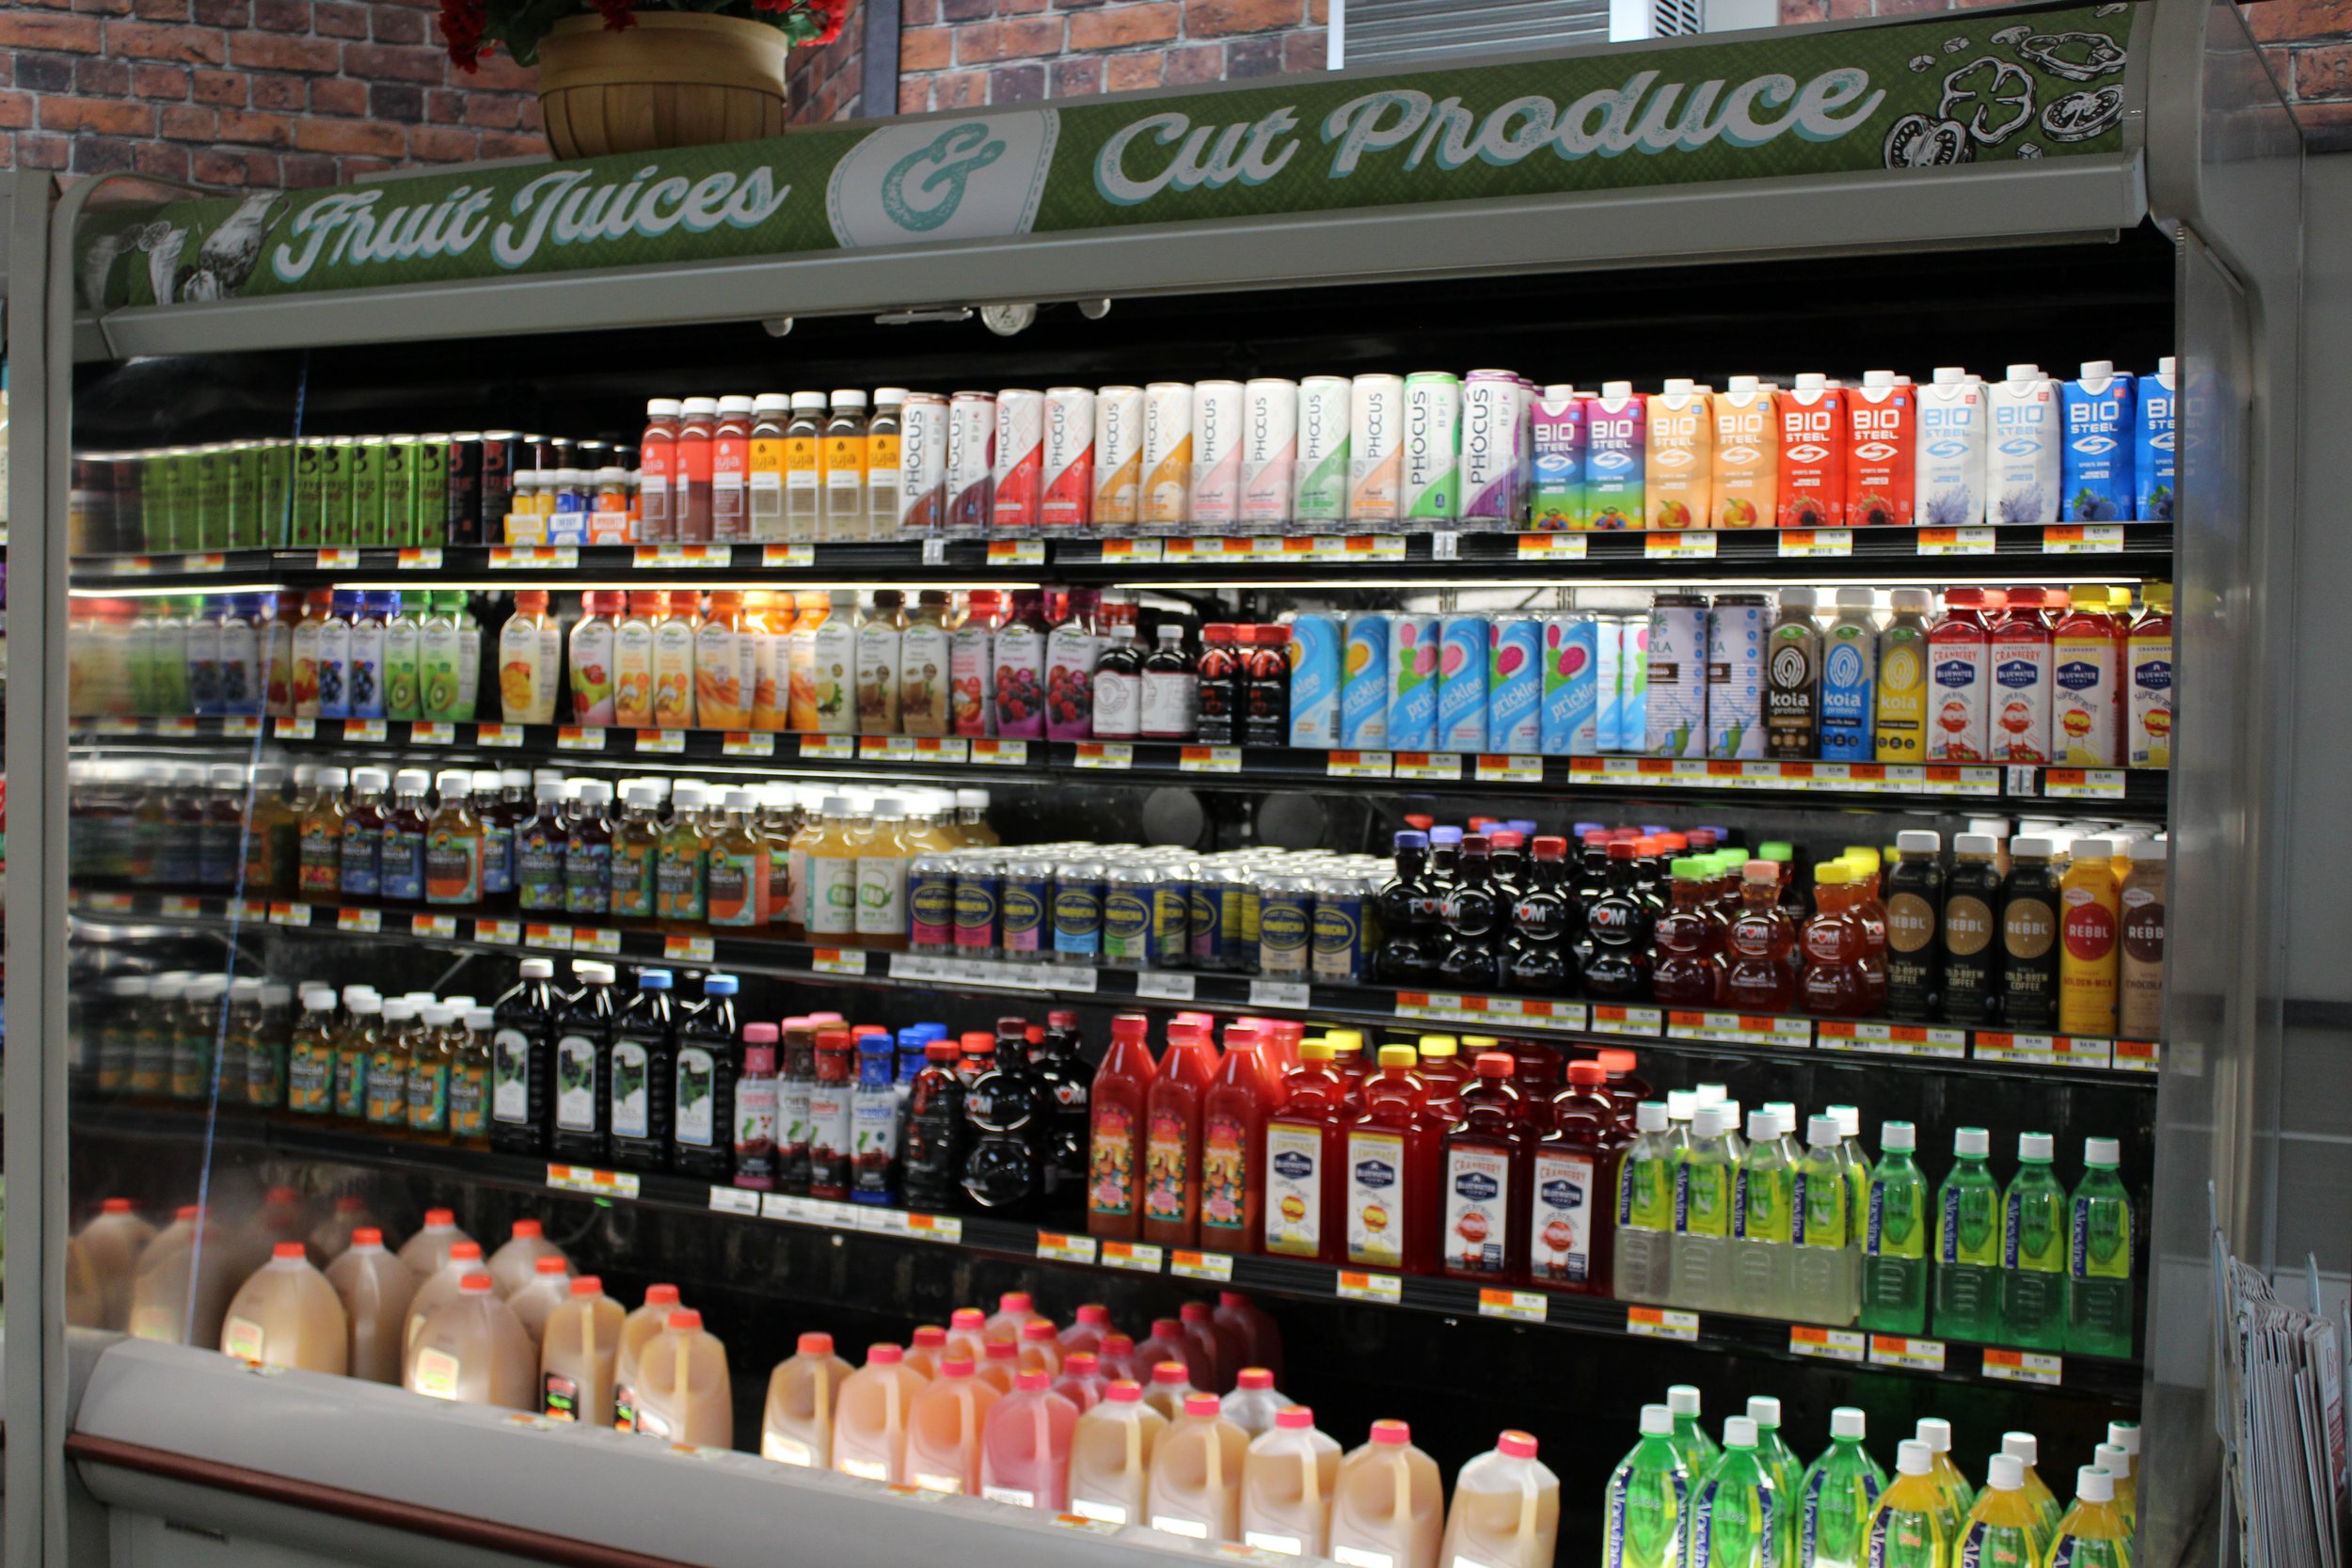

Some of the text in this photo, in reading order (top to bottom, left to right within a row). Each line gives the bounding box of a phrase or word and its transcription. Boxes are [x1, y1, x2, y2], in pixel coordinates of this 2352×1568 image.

[272, 67, 1885, 283] Fruit Juices & Cut Produce
[1852, 409, 1899, 430] BIO
[1924, 407, 1972, 427] BIO
[1996, 404, 2044, 424] BIO
[2070, 401, 2120, 422] BIO
[1203, 398, 1216, 462] PHOCUS
[1254, 397, 1267, 461] PHOCUS
[1309, 393, 1321, 459] PHOCUS
[1368, 393, 1383, 458] PHOCUS
[1591, 420, 1633, 440] BIO
[1653, 417, 1697, 437] BIO
[1718, 414, 1763, 435] BIO
[1784, 411, 1831, 432] BIO
[1996, 424, 2044, 436] STEEL
[2070, 422, 2119, 434] STEEL
[999, 405, 1010, 467] PHOCUS
[1052, 404, 1065, 467] PHOCUS
[1105, 403, 1120, 465] PHOCUS
[1146, 401, 1158, 463] PHOCUS
[1411, 390, 1426, 485] PHOCUS
[1470, 388, 1489, 484] PHOCUS
[1534, 423, 1575, 442] BIO
[1720, 434, 1762, 445] STEEL
[1785, 431, 1831, 443] STEEL
[1853, 429, 1899, 441] STEEL
[1925, 427, 1971, 438] STEEL
[1534, 441, 1573, 452] STEEL
[1592, 439, 1632, 450] STEEL
[1654, 436, 1695, 448] STEEL
[906, 410, 923, 497] PHOCUS
[948, 408, 961, 496] PHOCUS
[1934, 651, 1978, 662] CRANBERRY
[1995, 651, 2041, 662] CRANBERRY
[1937, 670, 1973, 678] BLUEWATER
[1551, 681, 1597, 722] prickle
[1770, 690, 1810, 706] koia
[1823, 689, 1862, 706] koia
[1881, 695, 1918, 710] koia
[1773, 707, 1806, 716] protein
[1826, 706, 1858, 715] protein
[1512, 902, 1546, 923] POM
[1588, 907, 1626, 926] POM
[1890, 916, 1926, 929] REBBL
[1947, 918, 1984, 932] REBBL
[2007, 921, 2048, 935] REBBL
[2069, 924, 2109, 938] REBBL
[1738, 926, 1768, 939] POM
[1809, 928, 1840, 944] POM
[2128, 926, 2164, 939] REBB
[2010, 981, 2041, 991] COFFEE
[1792, 1179, 1805, 1237] Aloevine
[1867, 1188, 1882, 1248] Aloevine
[1944, 1194, 1959, 1256] Aloevine
[1694, 1496, 1712, 1568] Aloevin
